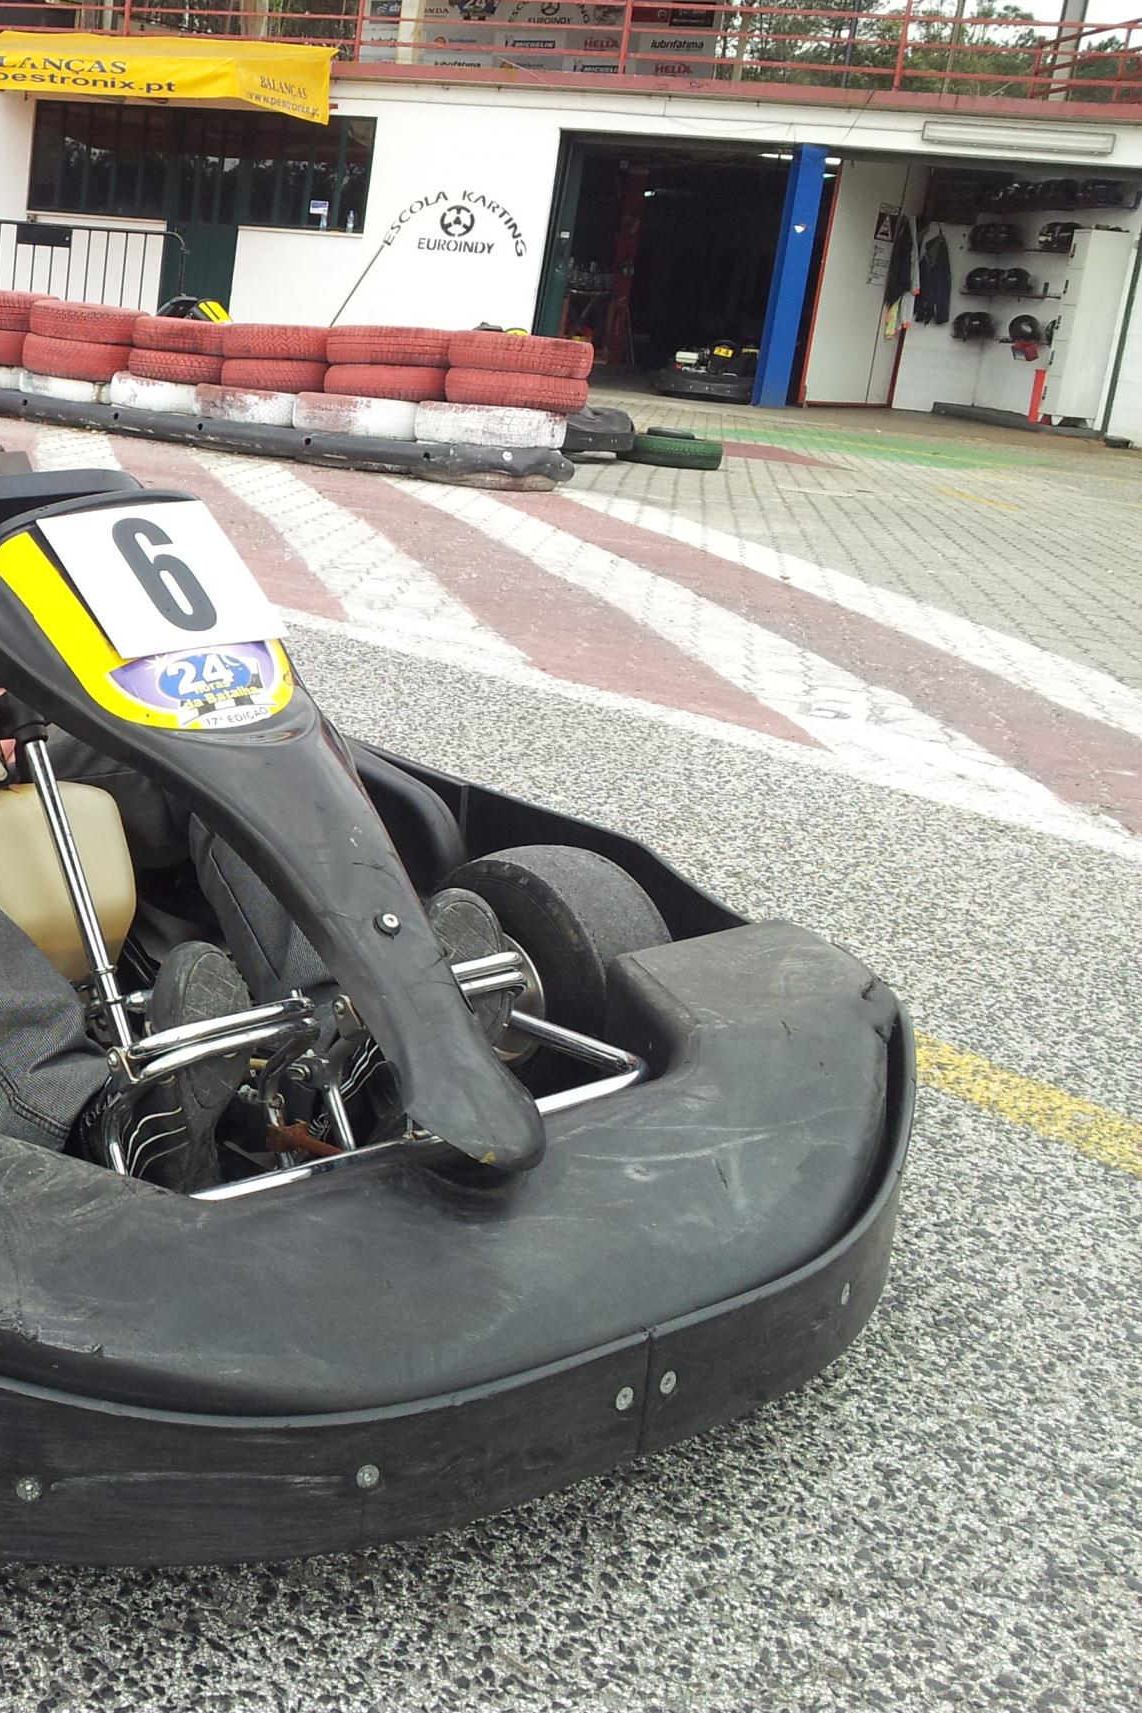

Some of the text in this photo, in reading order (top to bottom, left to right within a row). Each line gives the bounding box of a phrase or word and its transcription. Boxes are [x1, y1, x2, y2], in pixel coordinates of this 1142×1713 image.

[260, 75, 308, 100] BALANÇAS
[383, 190, 527, 257] ESCOLA KARTING
[417, 237, 495, 254] EUROINDY
[112, 517, 218, 632] 6
[165, 653, 235, 696] 24
